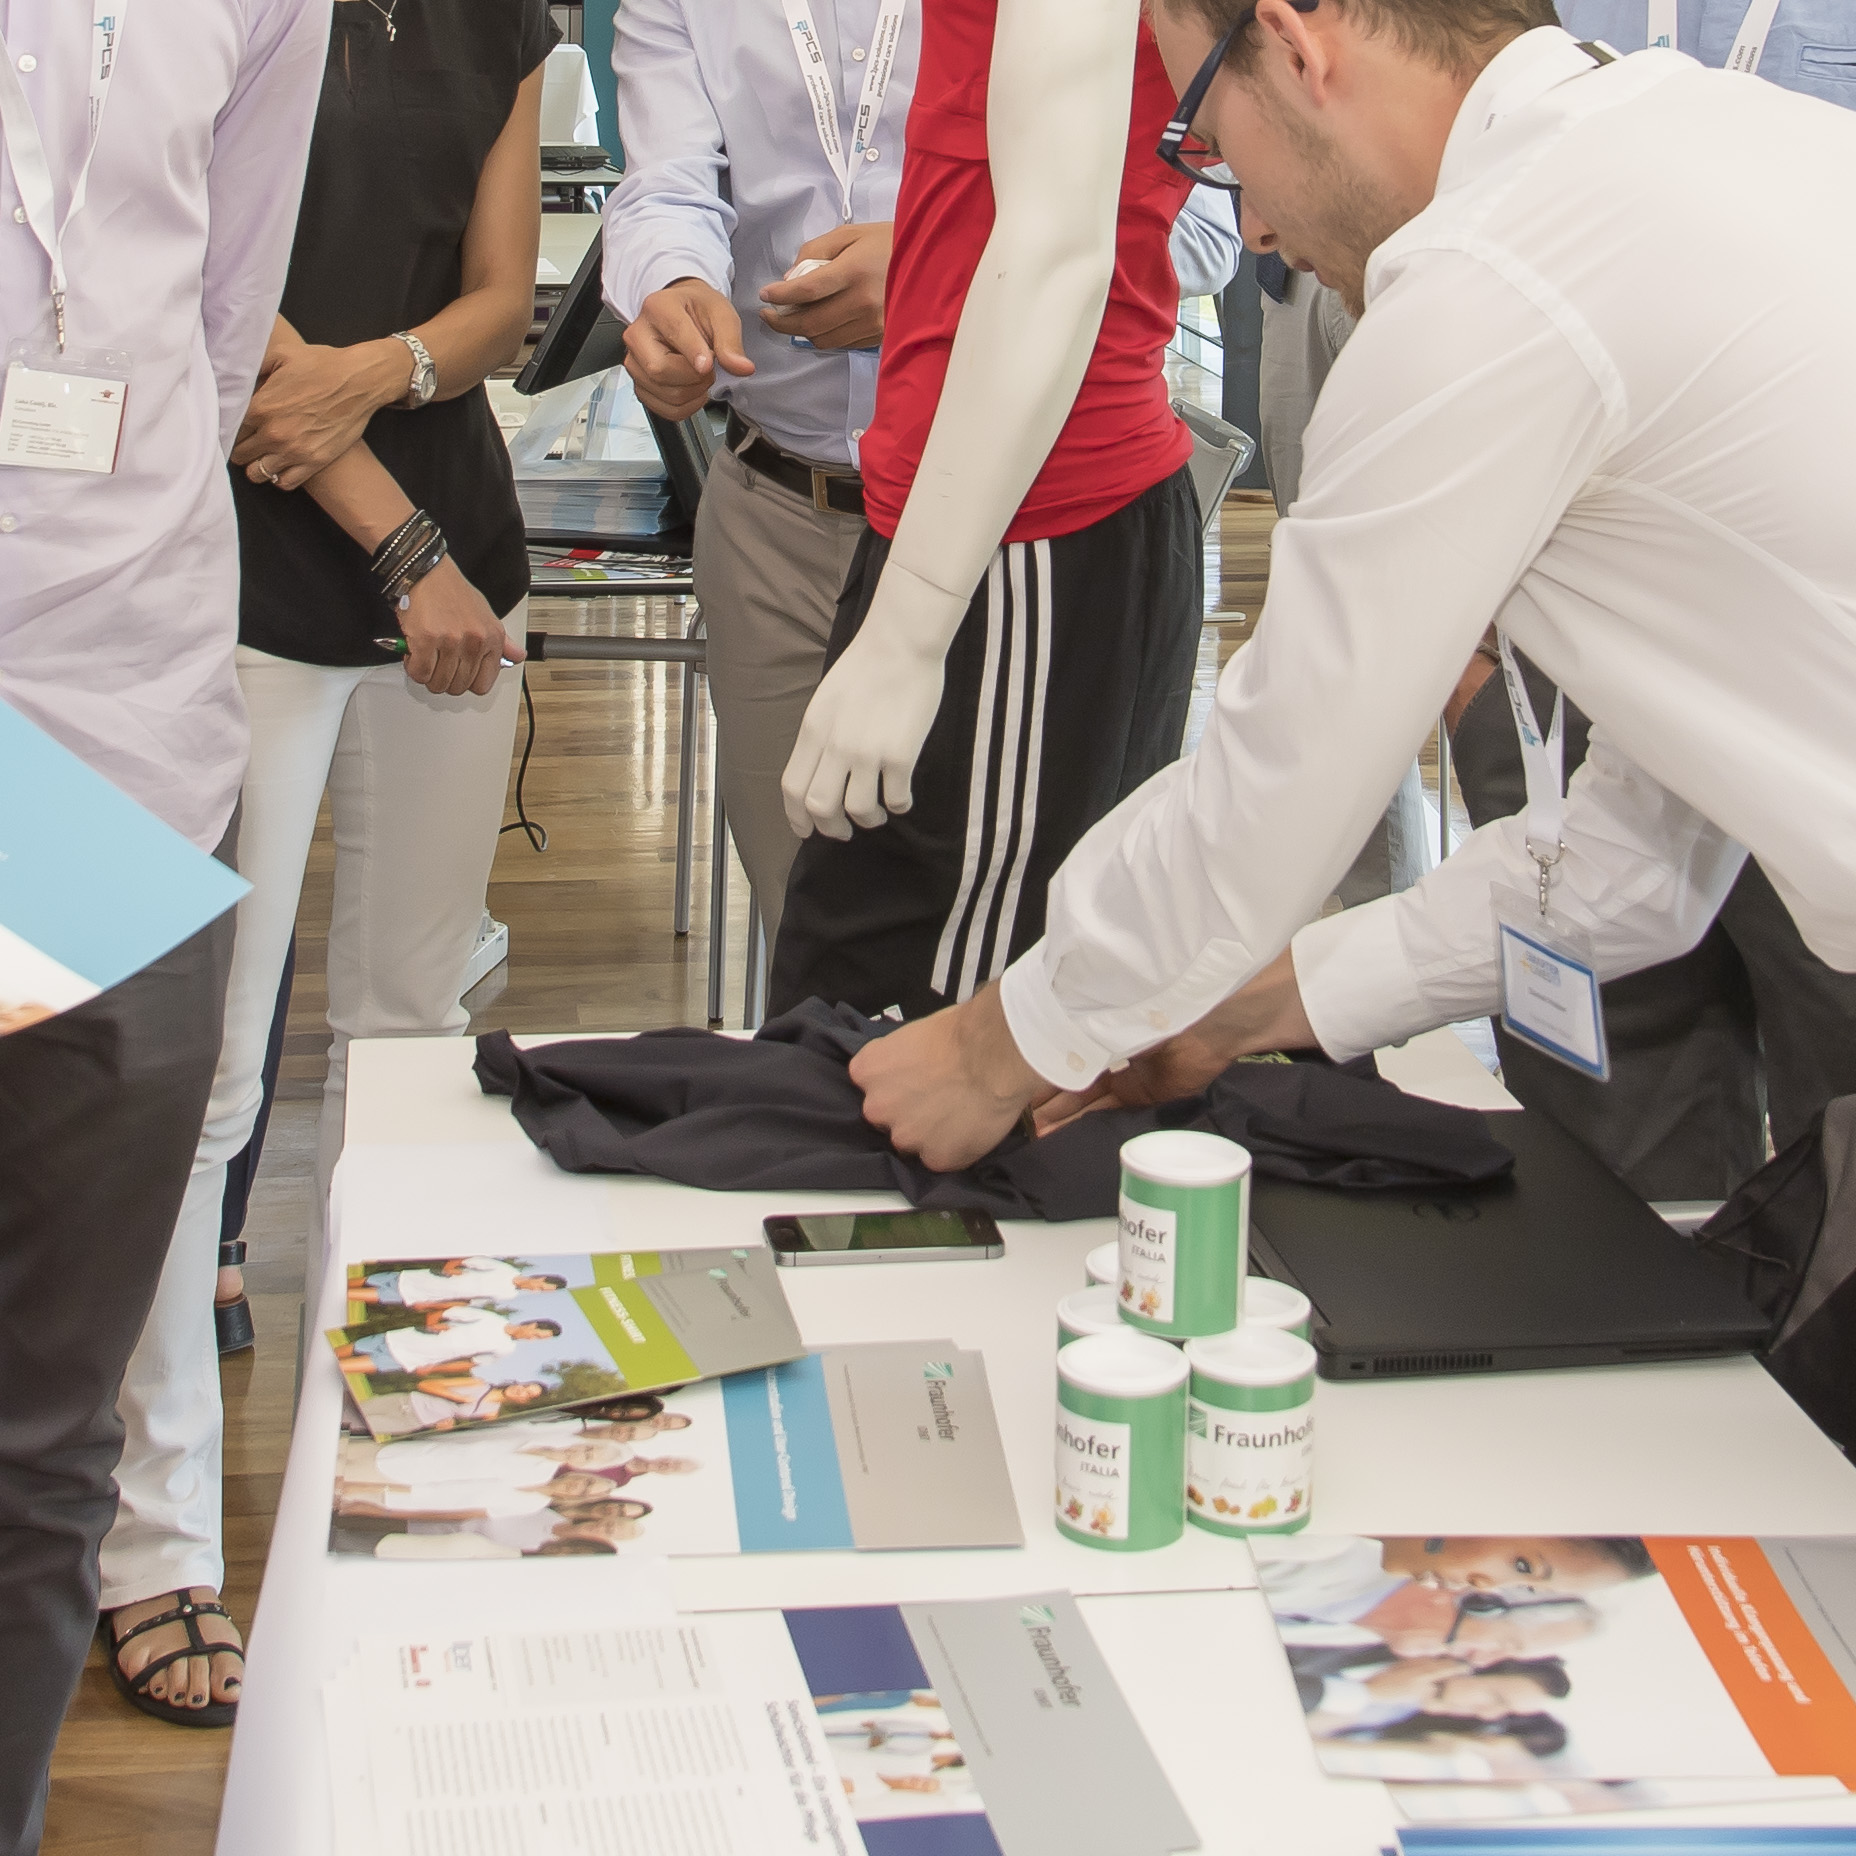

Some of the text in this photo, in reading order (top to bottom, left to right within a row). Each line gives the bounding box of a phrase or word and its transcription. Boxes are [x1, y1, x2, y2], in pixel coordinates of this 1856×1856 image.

[792, 19, 823, 64] 2PCS
[855, 104, 873, 154] 2PCS
[1131, 1244, 1167, 1264] ITALIA
[927, 1379, 959, 1441] Fraunhofer
[1079, 1460, 1121, 1478] ITALIA
